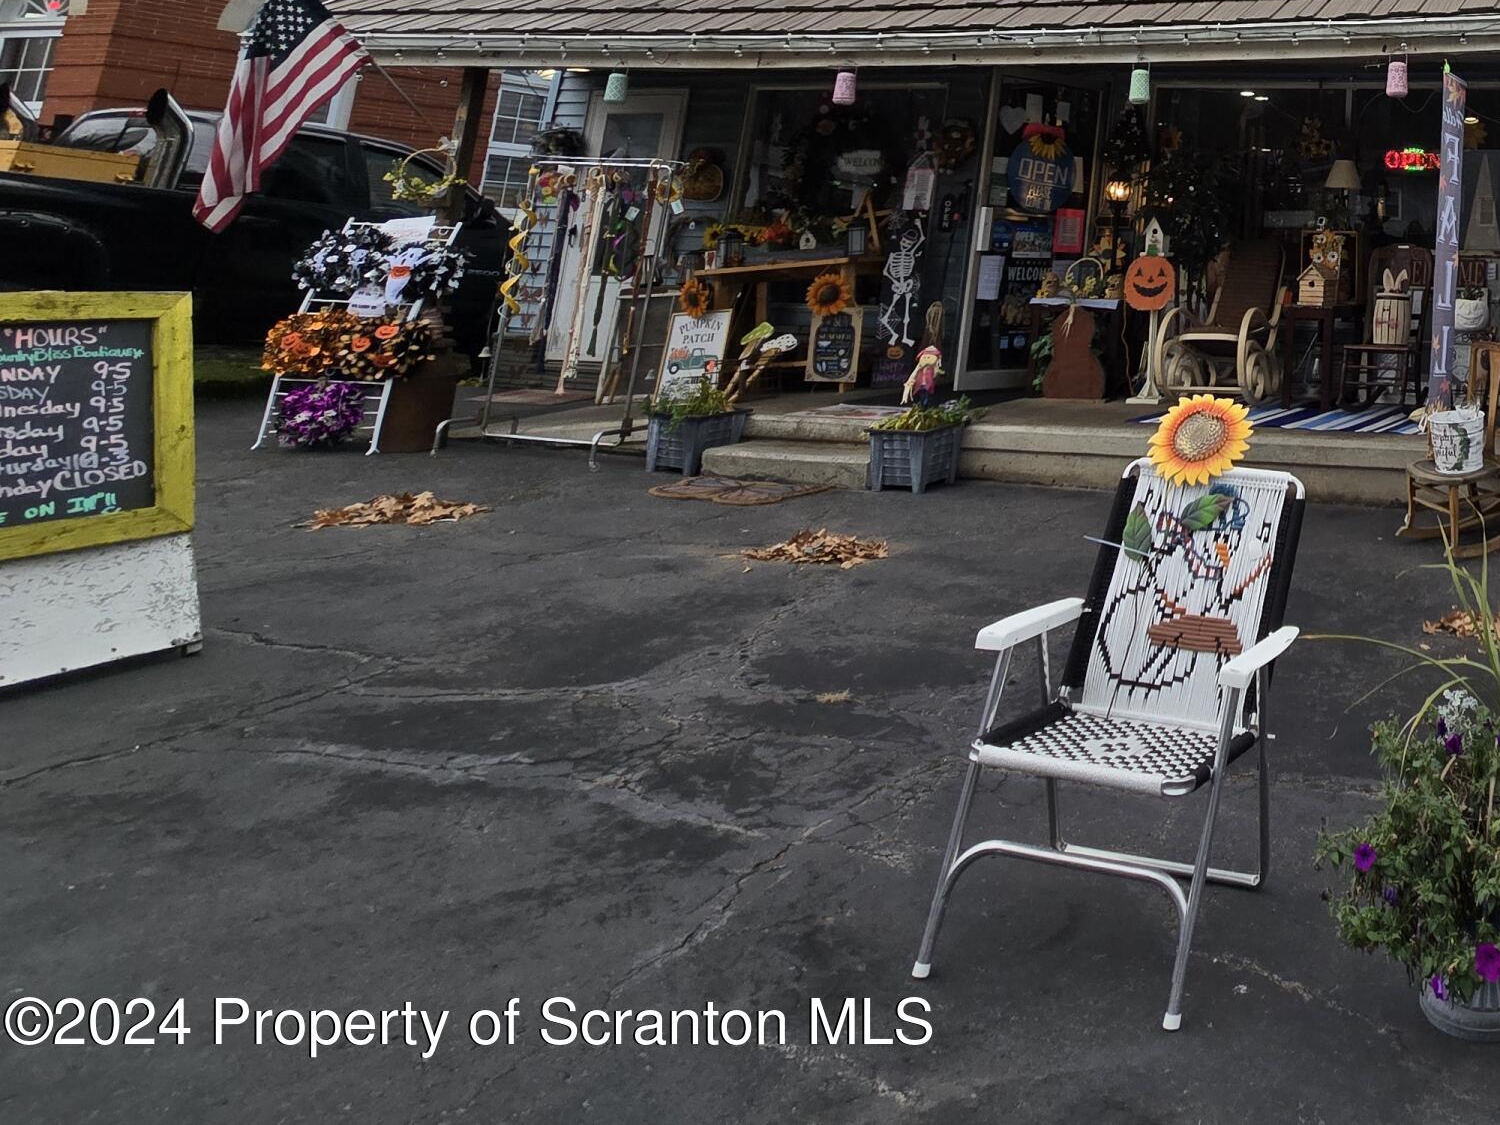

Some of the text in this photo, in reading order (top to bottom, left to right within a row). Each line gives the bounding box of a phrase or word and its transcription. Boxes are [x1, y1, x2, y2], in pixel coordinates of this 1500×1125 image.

[1384, 149, 1441, 169] OPEN
[1018, 157, 1069, 186] OPEN
[1008, 266, 1052, 283] WELCOM
[682, 332, 715, 345] PATCH
[93, 361, 132, 380] 9-5
[91, 379, 128, 397] 9-5
[89, 396, 125, 414] 9-5
[82, 415, 125, 433] 9-5
[80, 434, 129, 453] 9-5
[53, 460, 148, 491] CLOSED
[24, 501, 56, 520] ON
